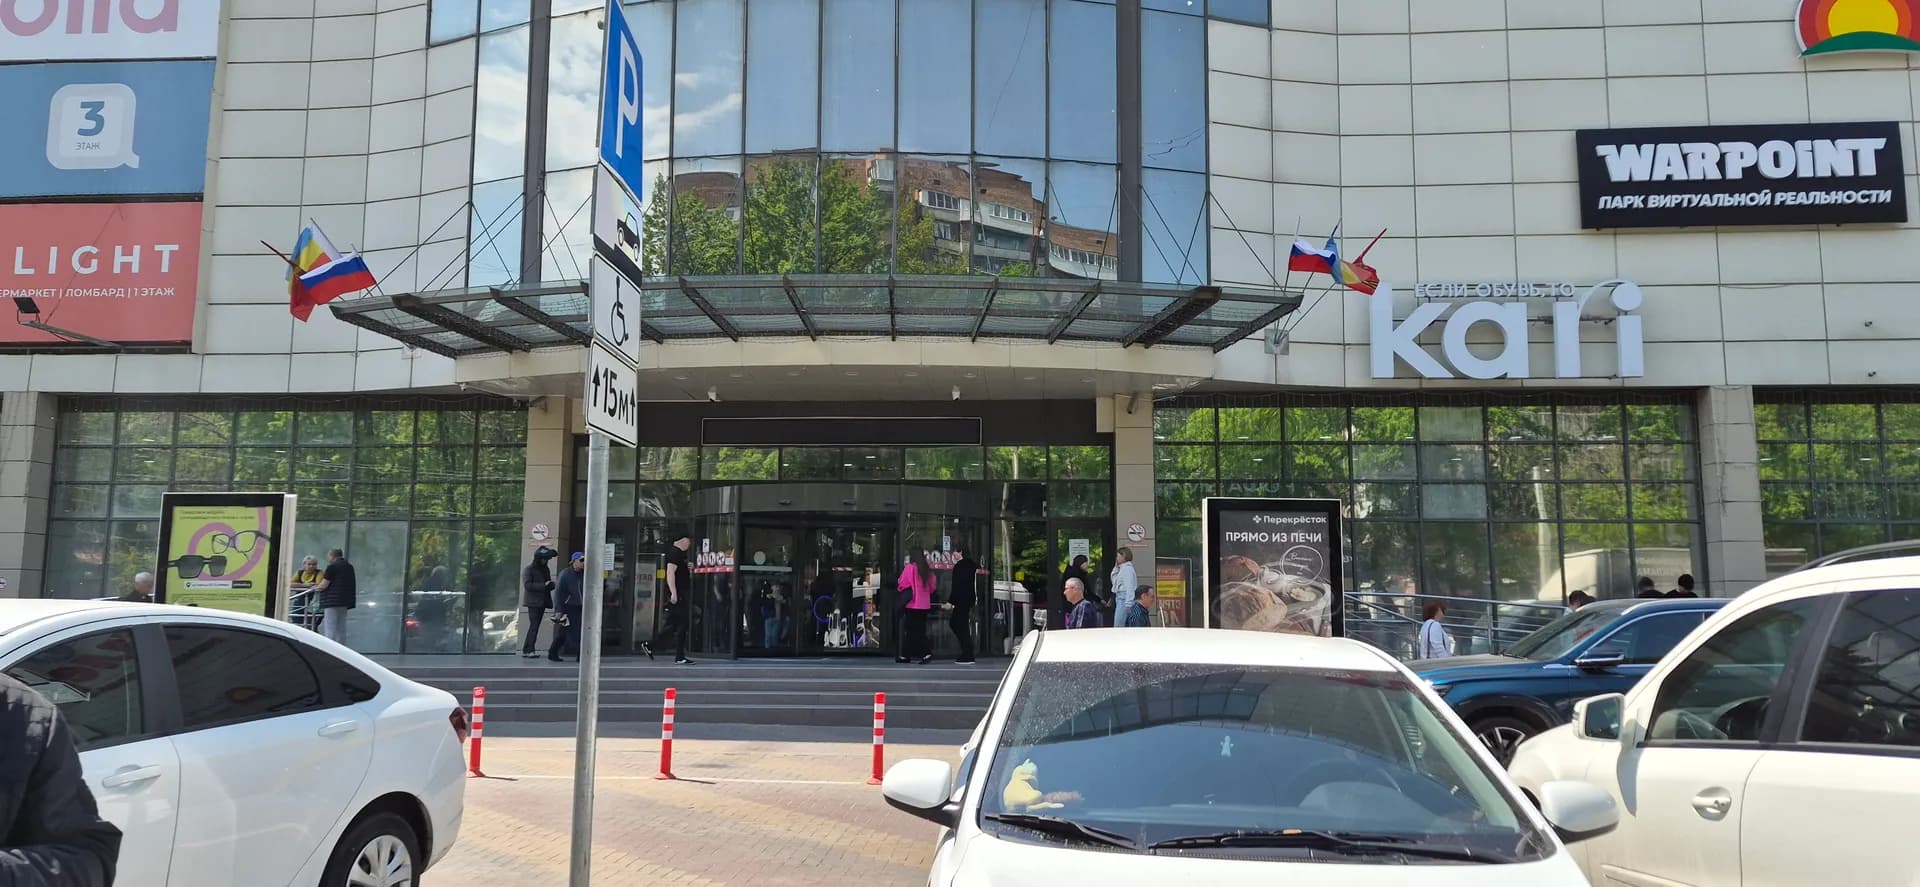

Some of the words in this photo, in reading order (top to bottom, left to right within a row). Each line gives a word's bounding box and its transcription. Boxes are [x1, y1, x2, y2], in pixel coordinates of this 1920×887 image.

[616, 32, 638, 159] P
[77, 101, 105, 137] 3
[75, 142, 101, 151] ЭТАЖ
[1598, 194, 1647, 209] ПАРК
[1647, 189, 1773, 208] ВИРТУАЛЬНОЙ
[1774, 189, 1892, 205] РЕАЛЬНОСТИ
[14, 244, 179, 275] LIGHT
[65, 288, 125, 298] ЛОМБАРД
[133, 288, 138, 297] 1
[141, 287, 175, 296] ЭТАЖ
[1414, 283, 1468, 298] ЕСЛИ
[1370, 280, 1644, 379] kari
[1263, 515, 1327, 525] Перекрёсток
[1225, 531, 1269, 543] ПРЯМО
[1272, 532, 1287, 542] ИЗ
[1290, 532, 1322, 543] ПЕЧИ
